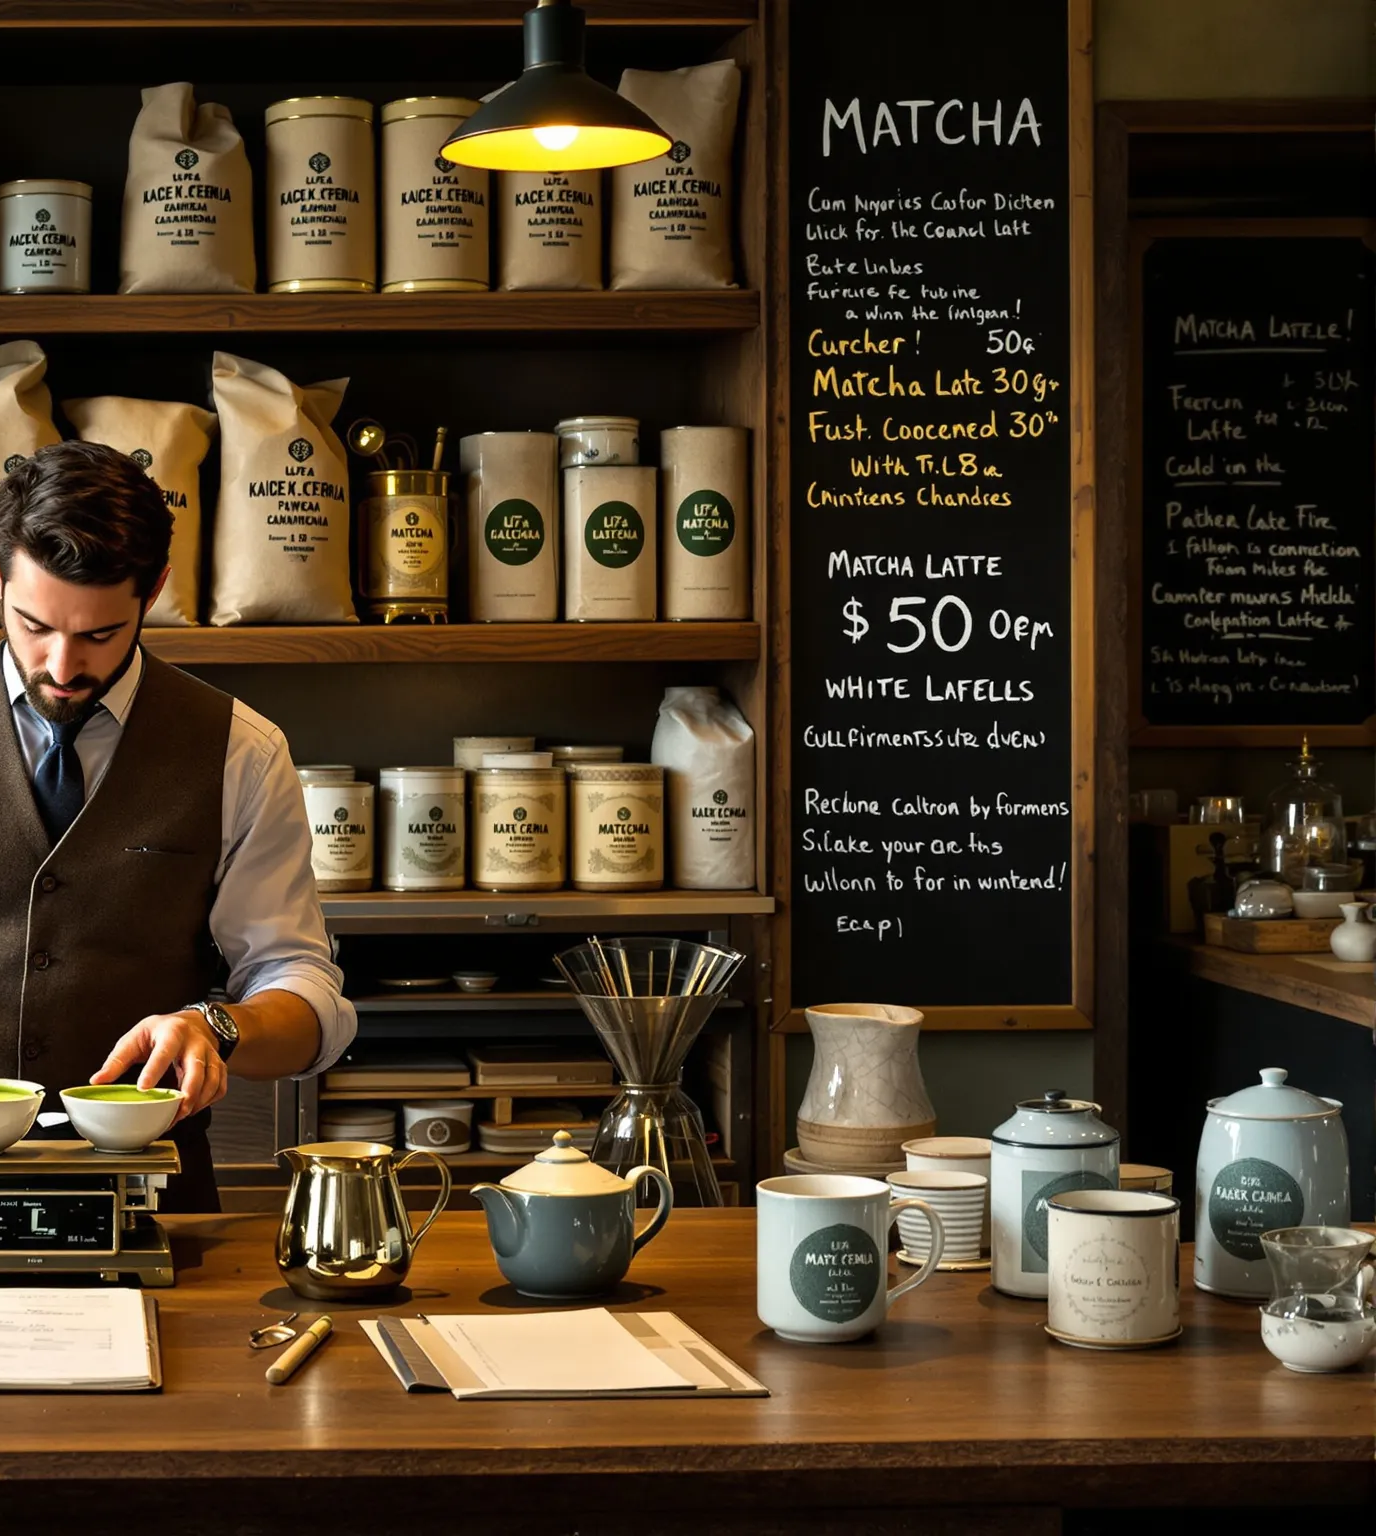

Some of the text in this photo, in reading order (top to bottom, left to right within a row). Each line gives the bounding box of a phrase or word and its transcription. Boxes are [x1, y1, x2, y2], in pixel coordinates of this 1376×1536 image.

[823, 98, 1042, 157] MATCHA
[911, 305, 939, 320] the
[1174, 313, 1256, 345] MATCHA
[813, 364, 926, 399] Matcha
[925, 553, 1003, 579] LATTE
[886, 594, 973, 653] 50
[825, 675, 911, 700] WHITE
[970, 795, 991, 820] by
[881, 839, 925, 864] your
[913, 865, 945, 892] for
[953, 873, 972, 890] in
